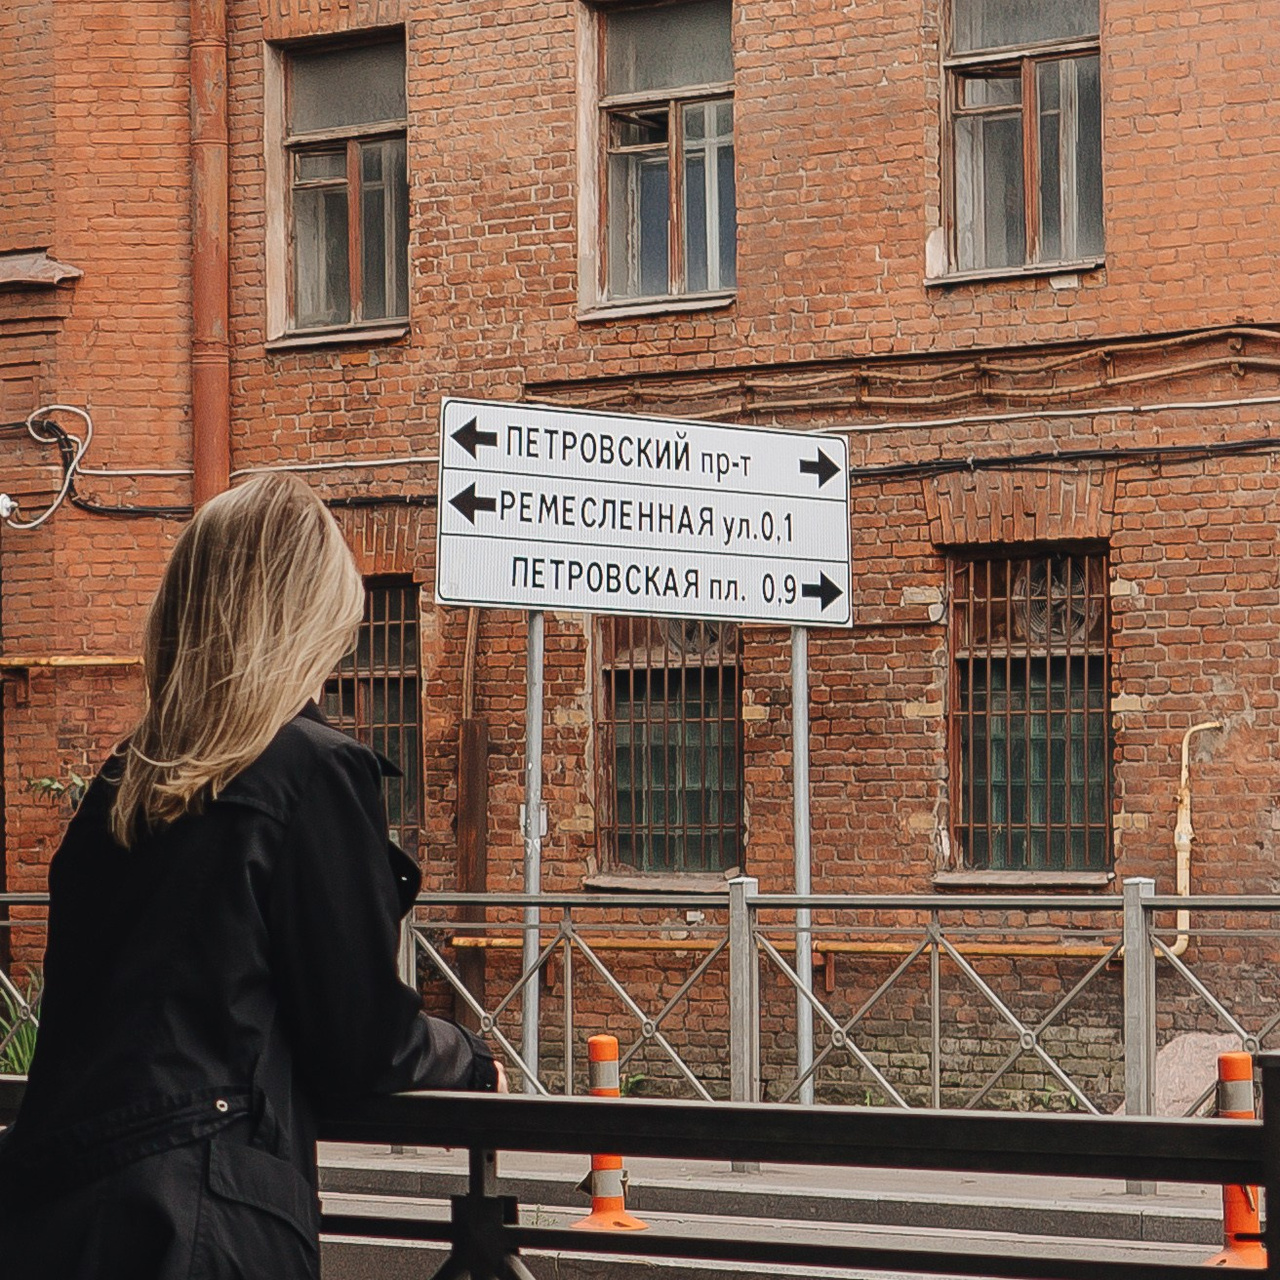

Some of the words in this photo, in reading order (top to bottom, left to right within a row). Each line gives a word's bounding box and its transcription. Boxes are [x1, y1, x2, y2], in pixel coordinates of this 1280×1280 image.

[506, 425, 690, 472] ПЕТРОВСКИЙ
[701, 451, 751, 483] пр-т
[500, 490, 714, 537] РЕМЕСЛЕННАЯ
[511, 556, 699, 599] ПЕТРОВСКАЯ
[710, 578, 746, 602] пл.
[762, 572, 797, 607] 0,9
